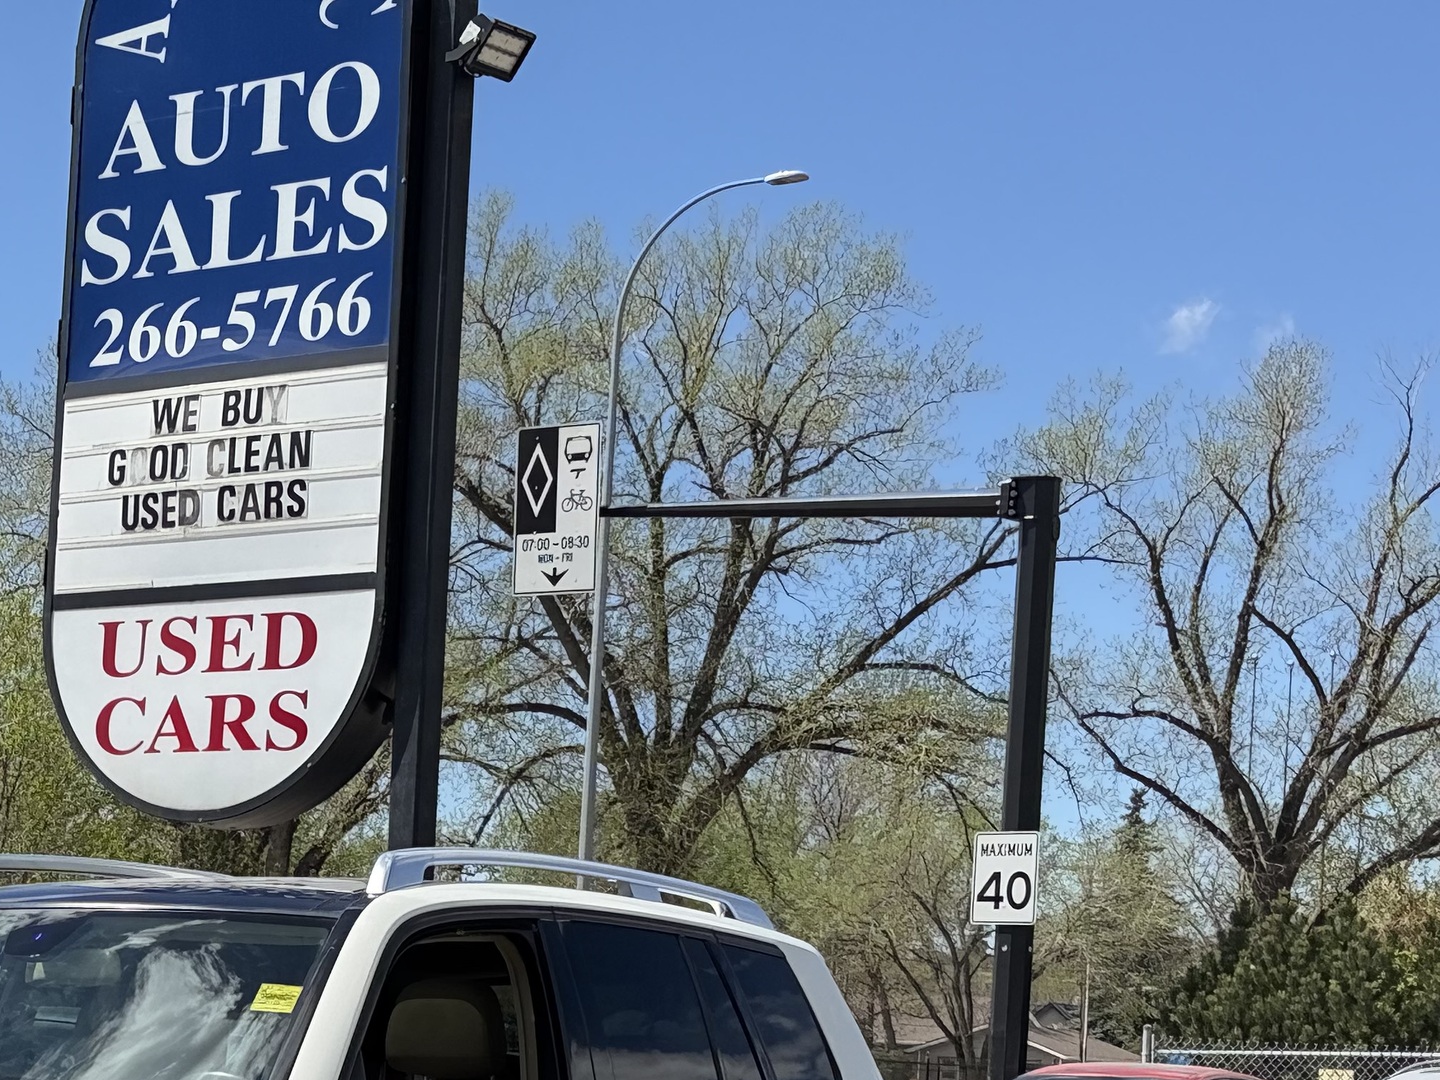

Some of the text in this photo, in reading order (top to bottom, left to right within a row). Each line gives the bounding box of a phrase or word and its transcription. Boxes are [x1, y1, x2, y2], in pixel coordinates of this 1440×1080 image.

[98, 61, 380, 180] AUTO
[81, 165, 389, 287] SALES
[89, 272, 374, 368] 266-5766
[152, 384, 287, 434] WE BUY
[108, 430, 312, 486] GOOD CLEAN
[121, 479, 307, 531] USED CARS
[98, 611, 318, 678] USED
[95, 689, 309, 756] CARS
[980, 843, 1033, 857] MAXIMUM
[976, 870, 1032, 910] 40
